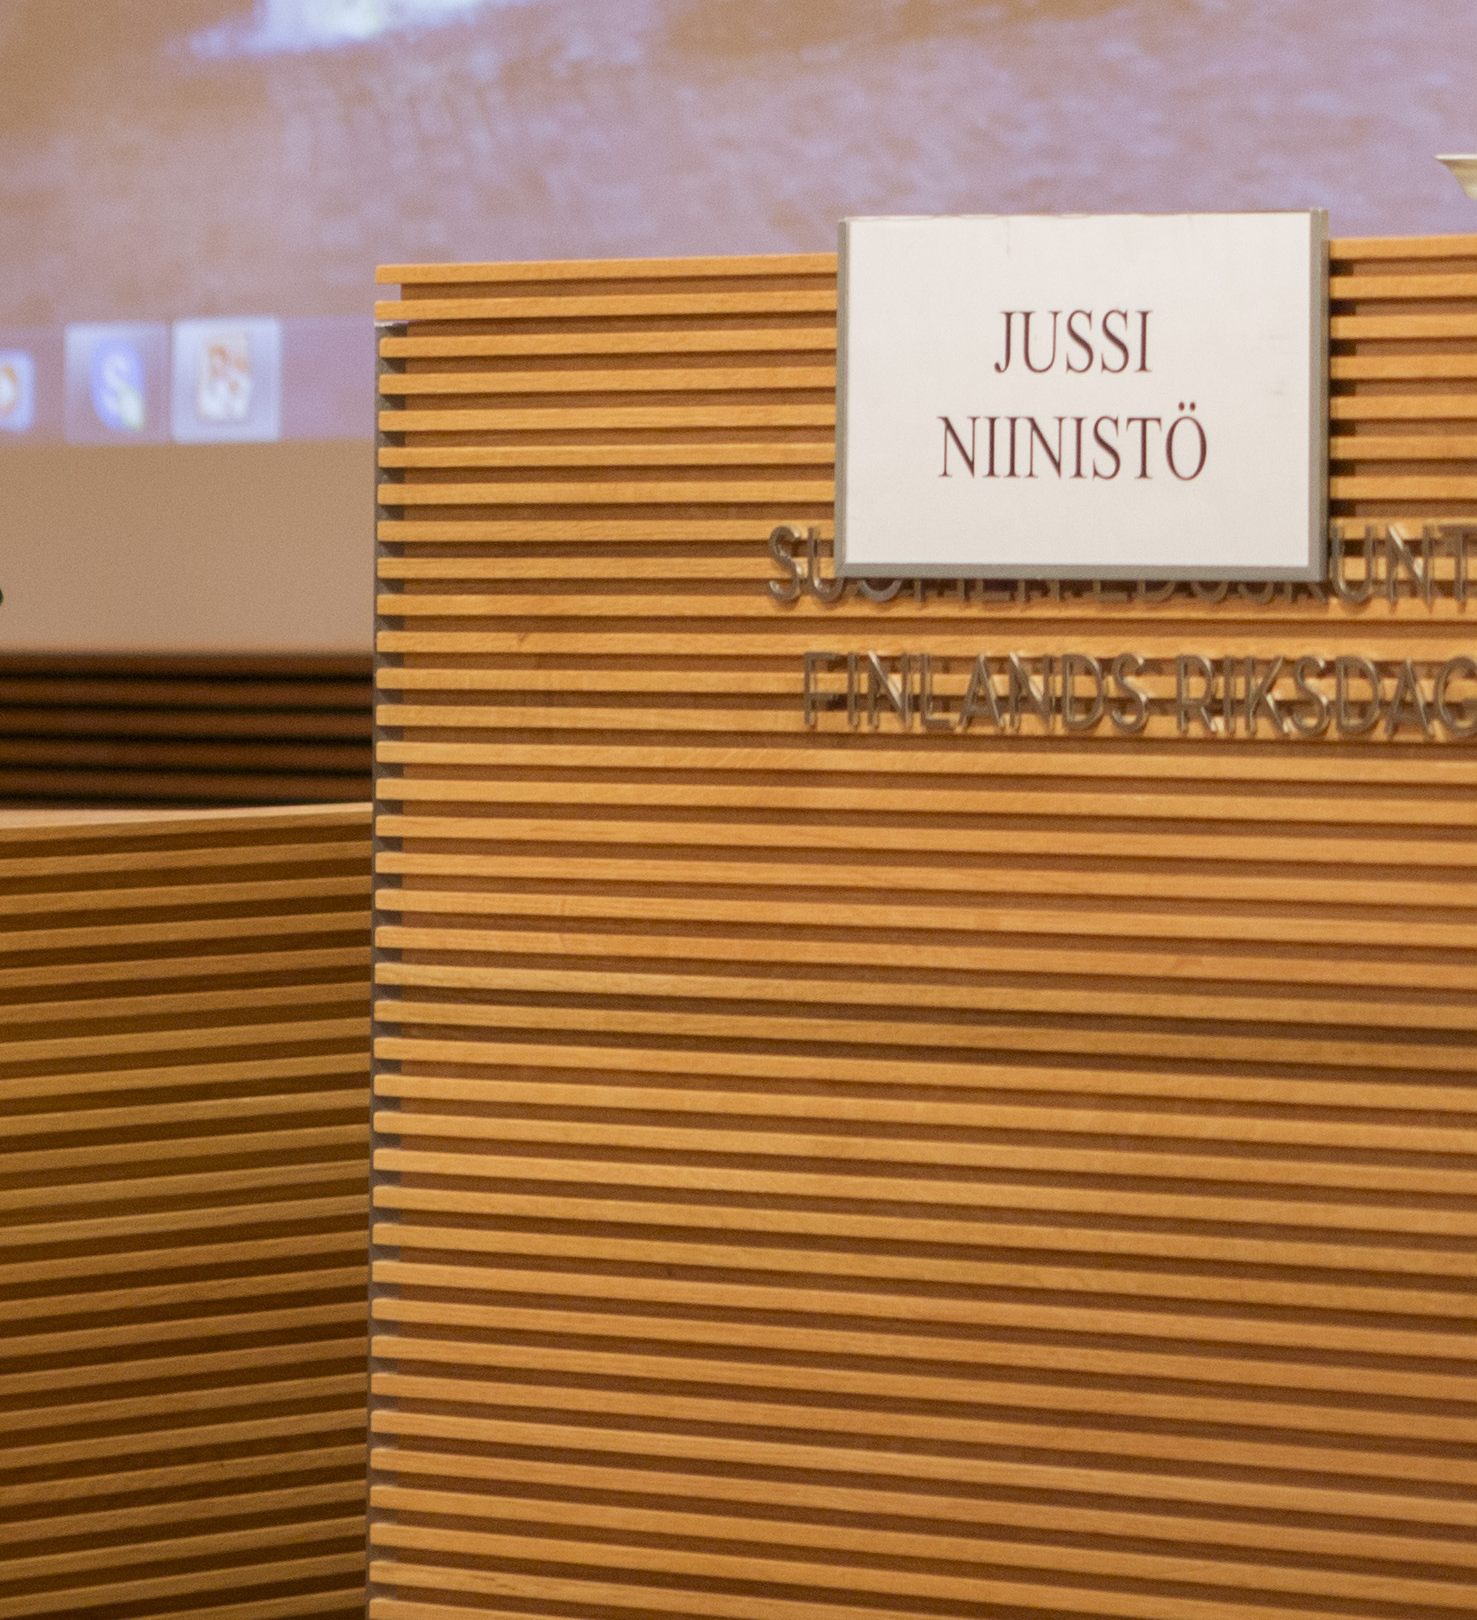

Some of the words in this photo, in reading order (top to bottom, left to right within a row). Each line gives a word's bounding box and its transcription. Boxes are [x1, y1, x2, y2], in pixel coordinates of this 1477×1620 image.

[994, 309, 1154, 374] JUSSI
[936, 400, 1207, 481] NIINISTÖ
[803, 650, 1149, 732] FINLANDS
